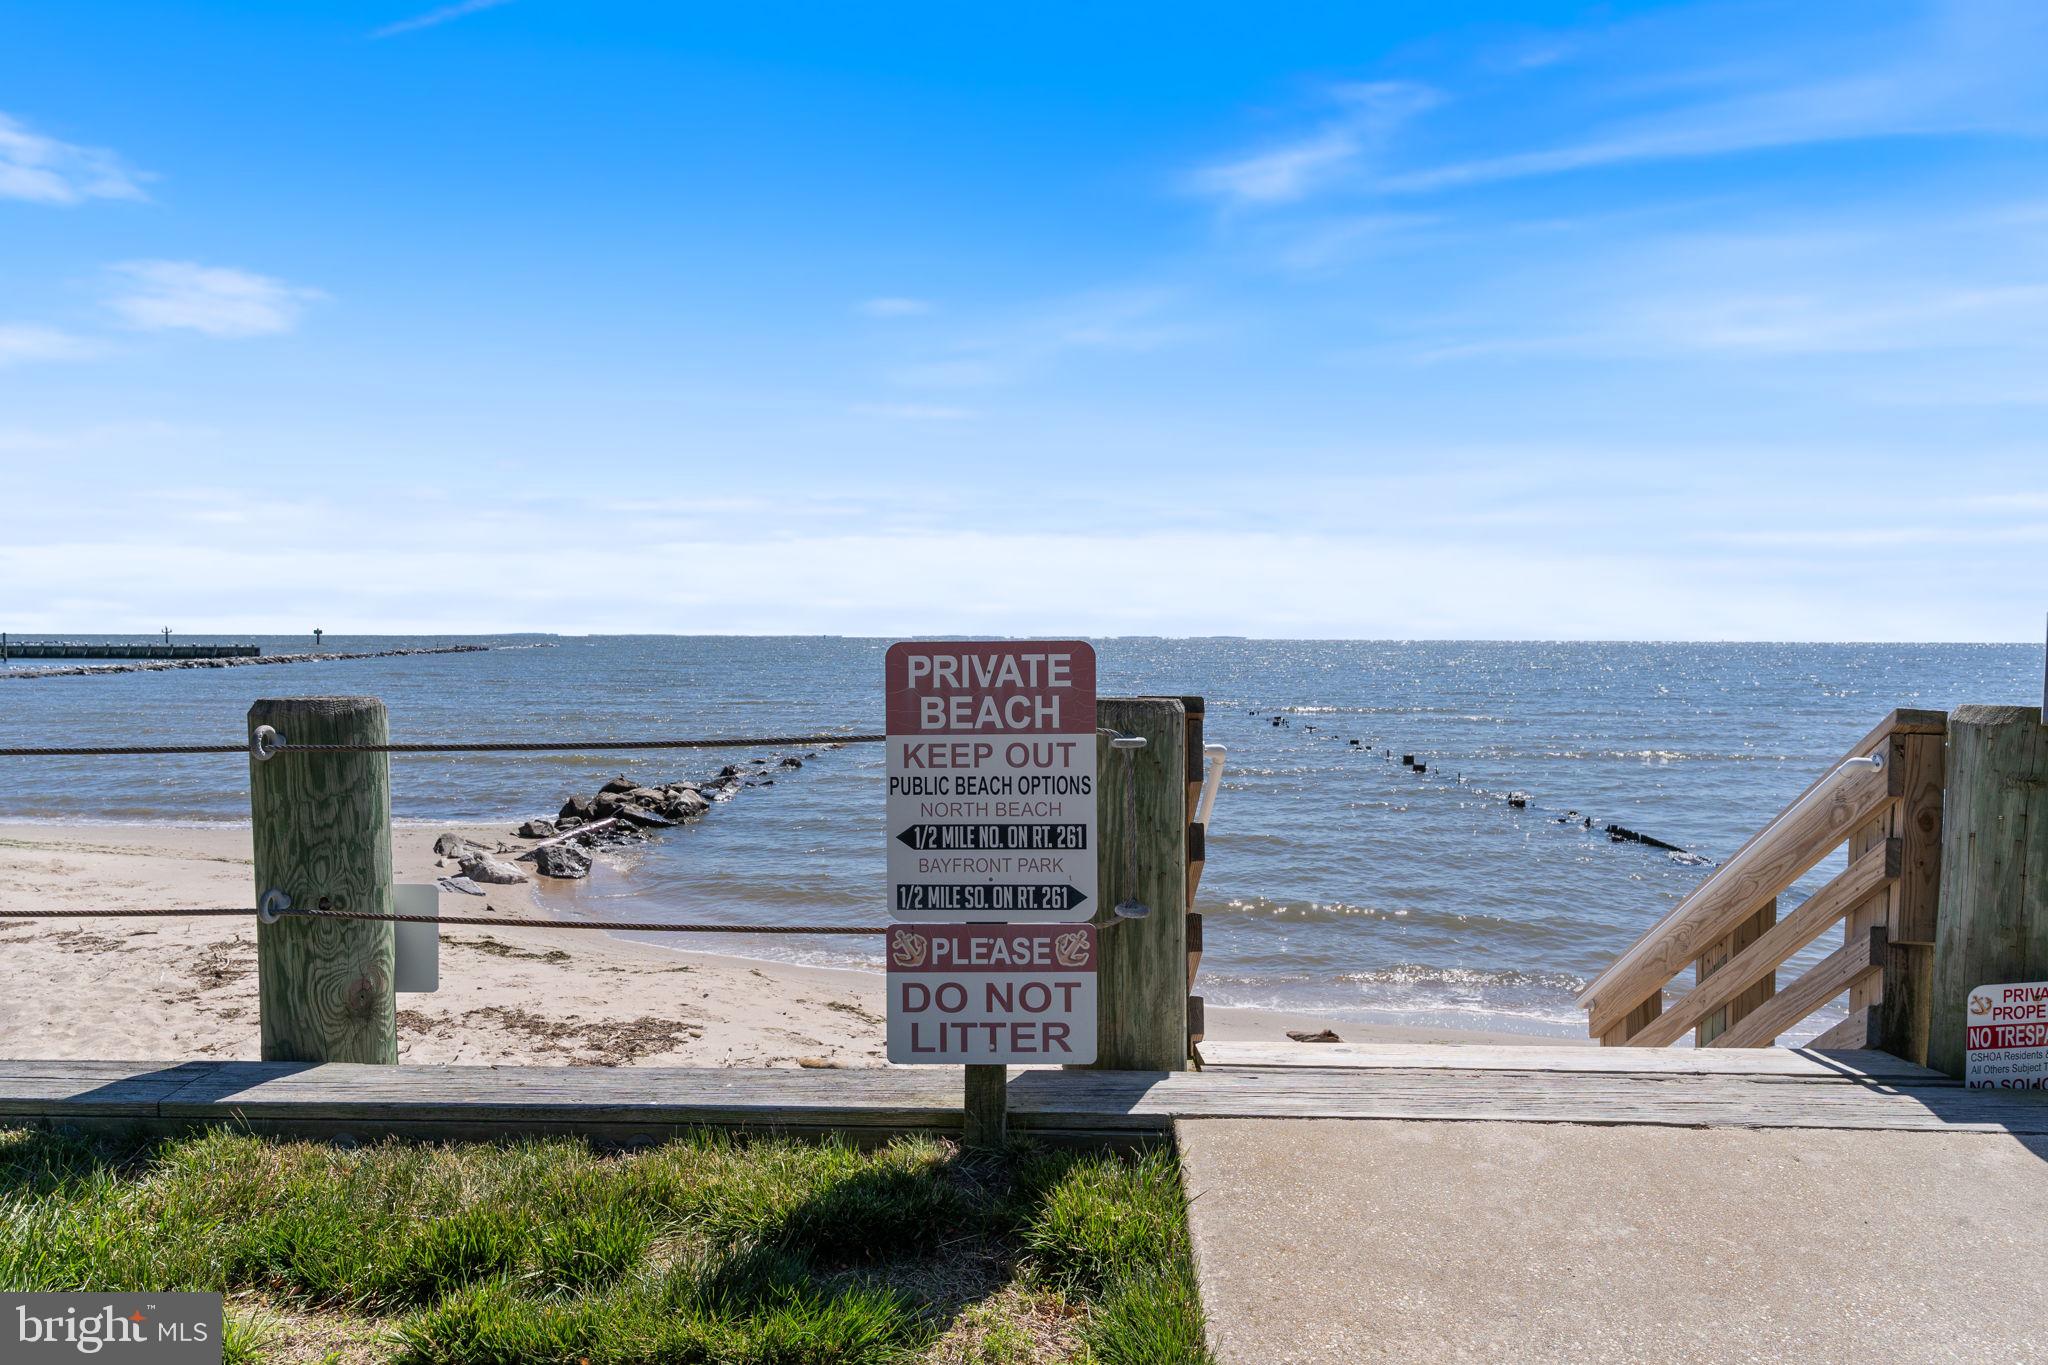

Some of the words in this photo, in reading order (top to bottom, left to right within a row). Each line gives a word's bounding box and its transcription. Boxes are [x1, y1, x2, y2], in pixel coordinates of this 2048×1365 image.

[907, 654, 1072, 688] PRIVATE
[920, 695, 1060, 730] BEACH
[903, 742, 993, 769] KEEP
[1005, 742, 1076, 768] OUT
[889, 776, 949, 795] PUBLIC
[955, 776, 1012, 795] BEACH
[1018, 775, 1091, 795] OPTIONS
[920, 802, 989, 817] NORTH
[995, 801, 1062, 817] BEACH
[914, 826, 936, 849] 1/2
[942, 826, 976, 849] MILE
[979, 825, 1004, 849] NO.
[1008, 825, 1028, 848] ON
[1033, 825, 1053, 848] RT.
[1057, 825, 1083, 848] 261
[918, 858, 1012, 873] BAYFRONT
[1018, 857, 1064, 873] PARK
[900, 886, 922, 910] 1/2
[928, 887, 960, 909] MILE
[964, 886, 989, 909] SO.
[993, 886, 1013, 909] ON
[1017, 886, 1038, 909] RT.
[1042, 886, 1068, 909] 261
[931, 937, 1051, 965] PLEASE
[902, 982, 968, 1013] DO
[986, 982, 1082, 1013] NOT
[1992, 1004, 2046, 1021] PROPE
[911, 1022, 1073, 1053] LITTER
[1969, 1027, 1992, 1049] NO
[1971, 1052, 2002, 1062] CSHOA
[2004, 1050, 2043, 1060] Residents
[1971, 1065, 1982, 1074] All
[1983, 1064, 2010, 1074] Others
[2012, 1063, 2042, 1074] Subject
